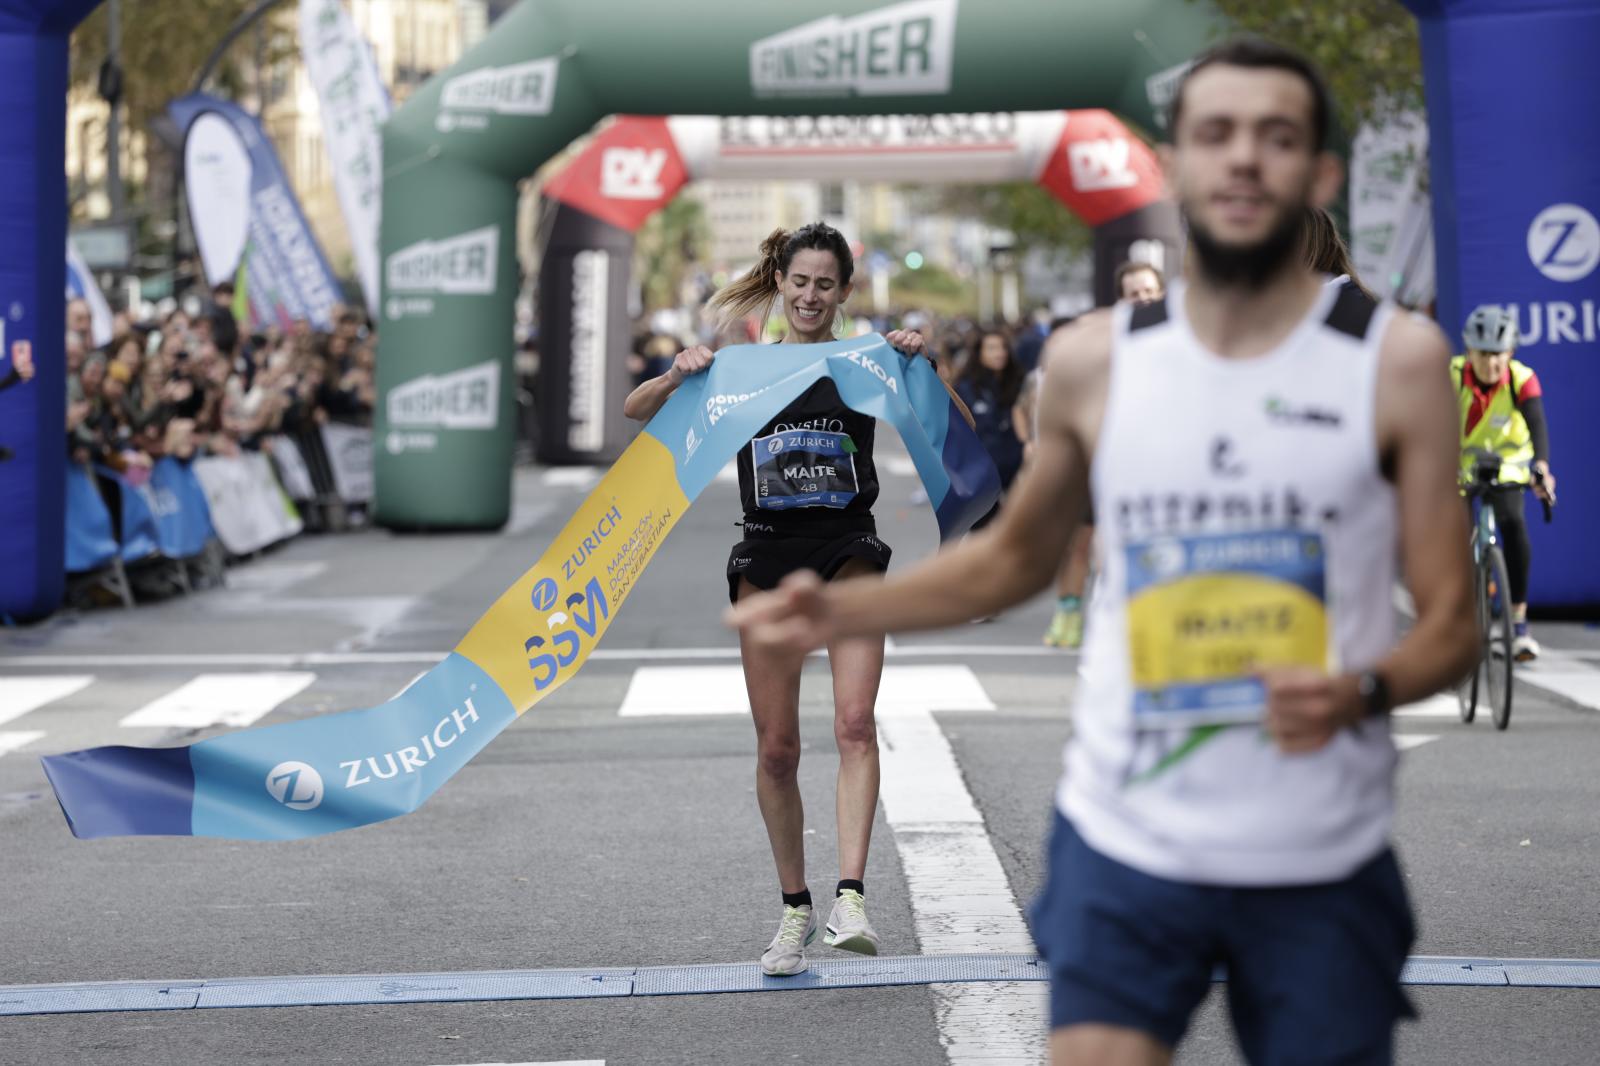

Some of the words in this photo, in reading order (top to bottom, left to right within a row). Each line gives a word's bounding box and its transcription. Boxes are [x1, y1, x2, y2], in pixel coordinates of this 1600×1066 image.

[759, 16, 932, 80] FINISHER
[1507, 299, 1600, 346] URI
[788, 437, 834, 449] ZURICH
[784, 465, 837, 480] MAITE
[800, 483, 818, 493] 48
[561, 505, 623, 581] ZURICH
[612, 575, 630, 607] SAN
[339, 697, 480, 789] ZURICH
